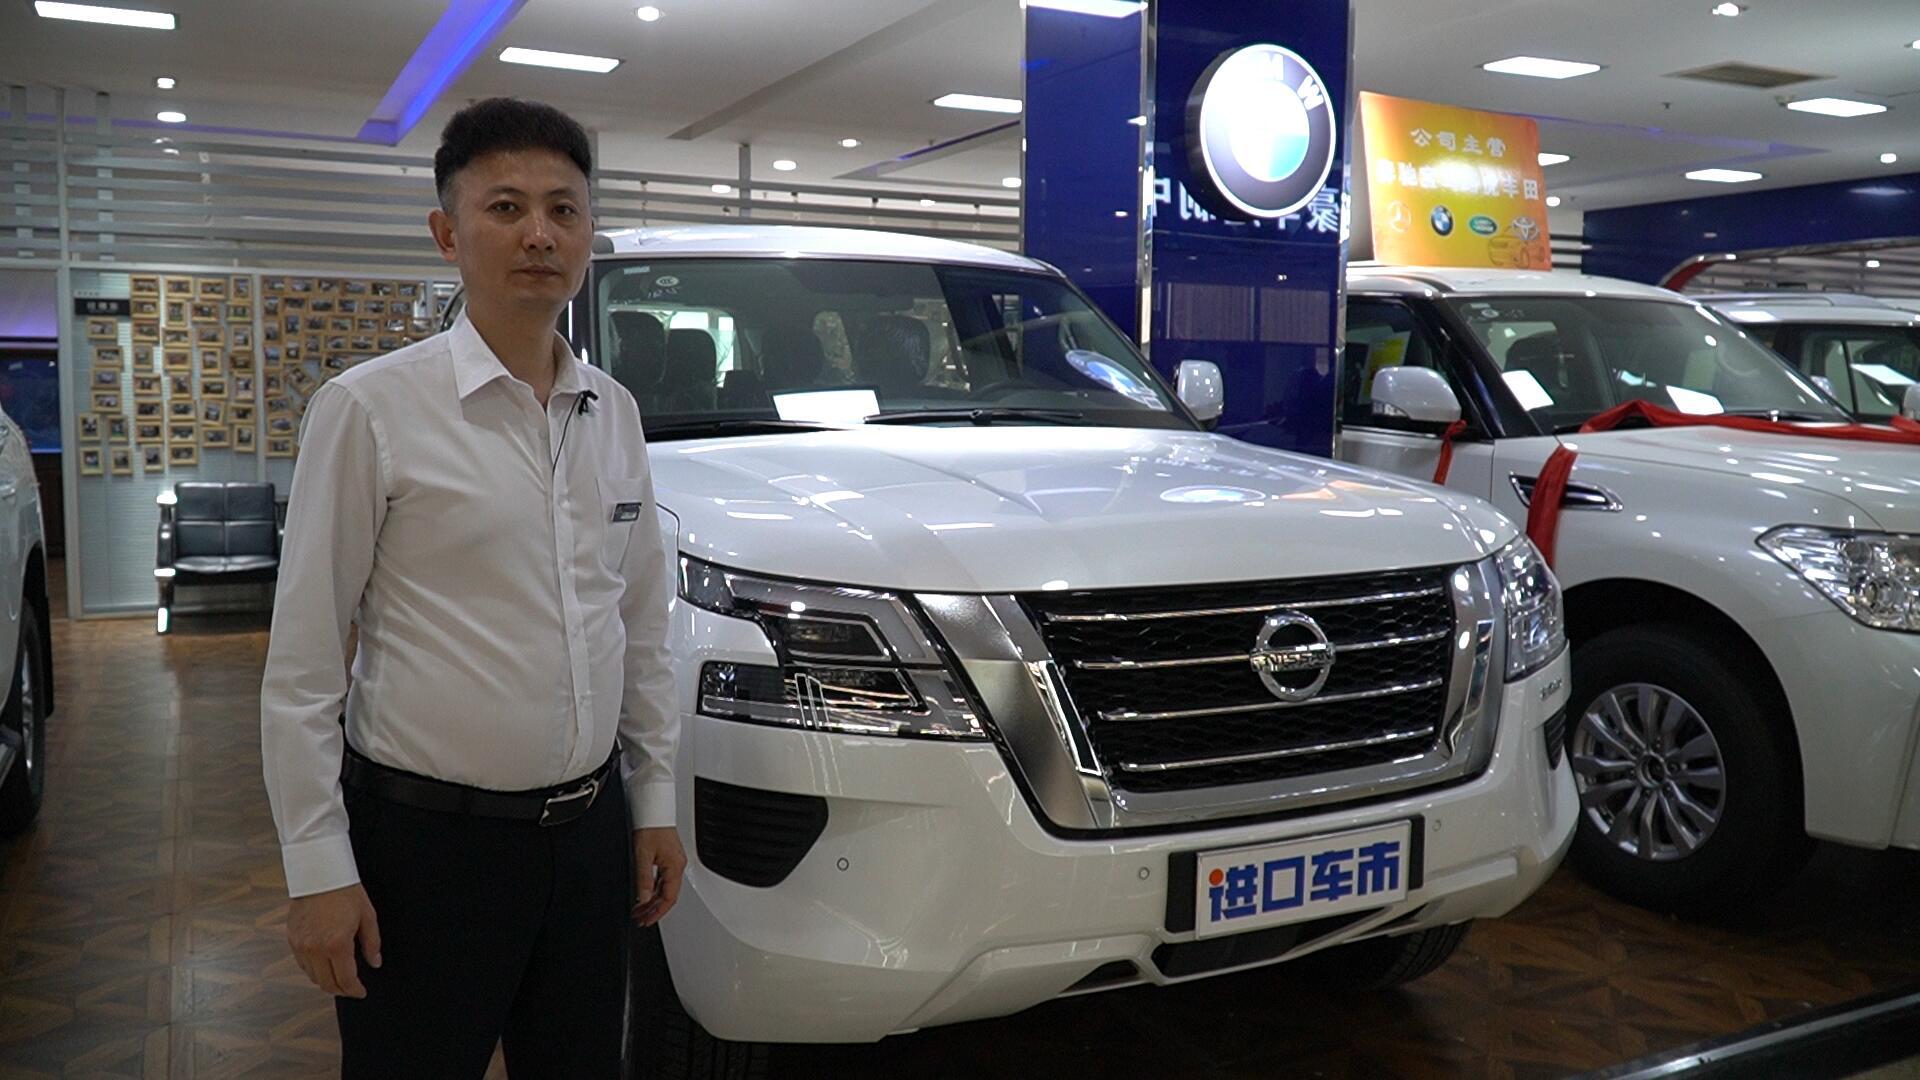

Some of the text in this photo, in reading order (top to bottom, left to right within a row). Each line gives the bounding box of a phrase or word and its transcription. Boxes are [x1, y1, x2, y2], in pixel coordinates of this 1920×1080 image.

[1410, 127, 1506, 157] 公司主营
[1208, 841, 1400, 923] 进口车市
